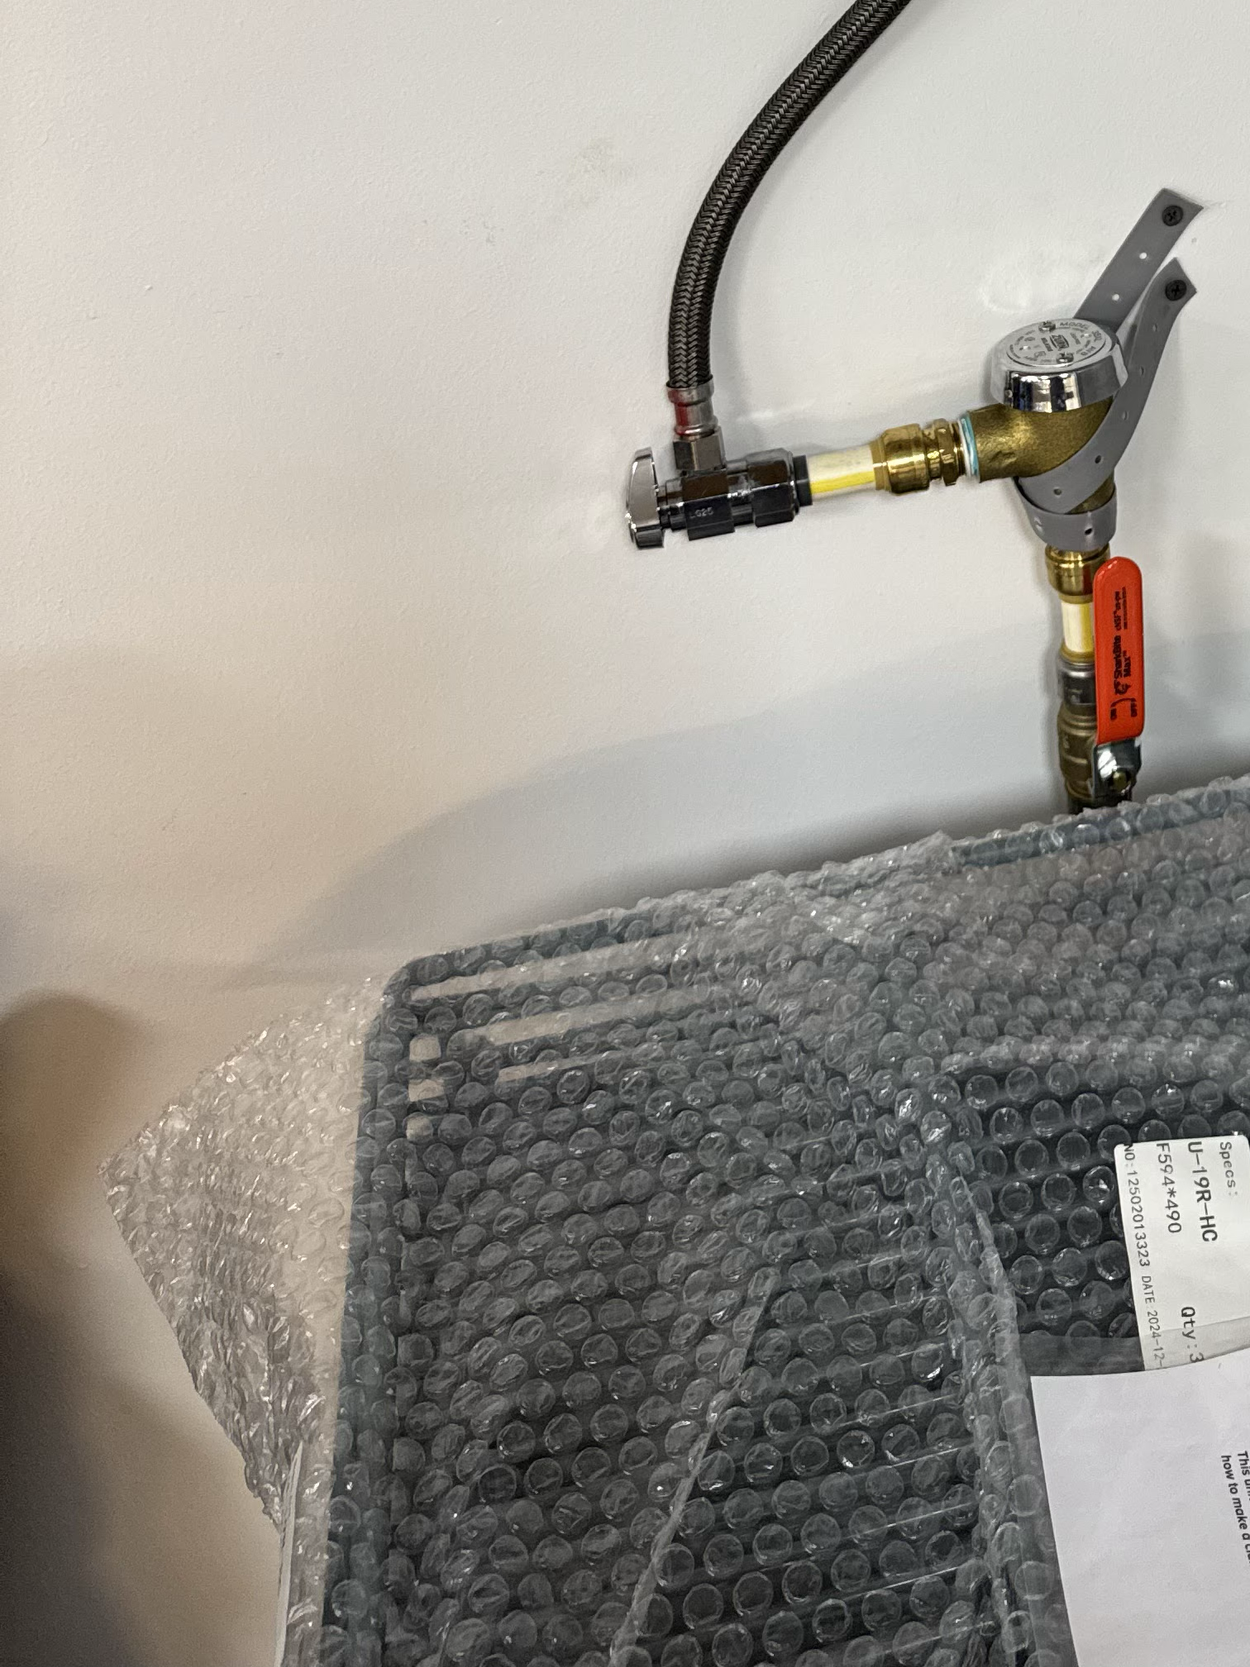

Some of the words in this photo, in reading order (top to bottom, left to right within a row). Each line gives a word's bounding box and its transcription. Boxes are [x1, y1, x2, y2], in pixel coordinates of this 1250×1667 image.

[1112, 635, 1122, 679] SharkBite
[1217, 1141, 1238, 1196] Specs:
[1187, 1141, 1218, 1242] U-19R-HC
[1220, 1452, 1239, 1481] how
[1228, 1481, 1243, 1495] to
